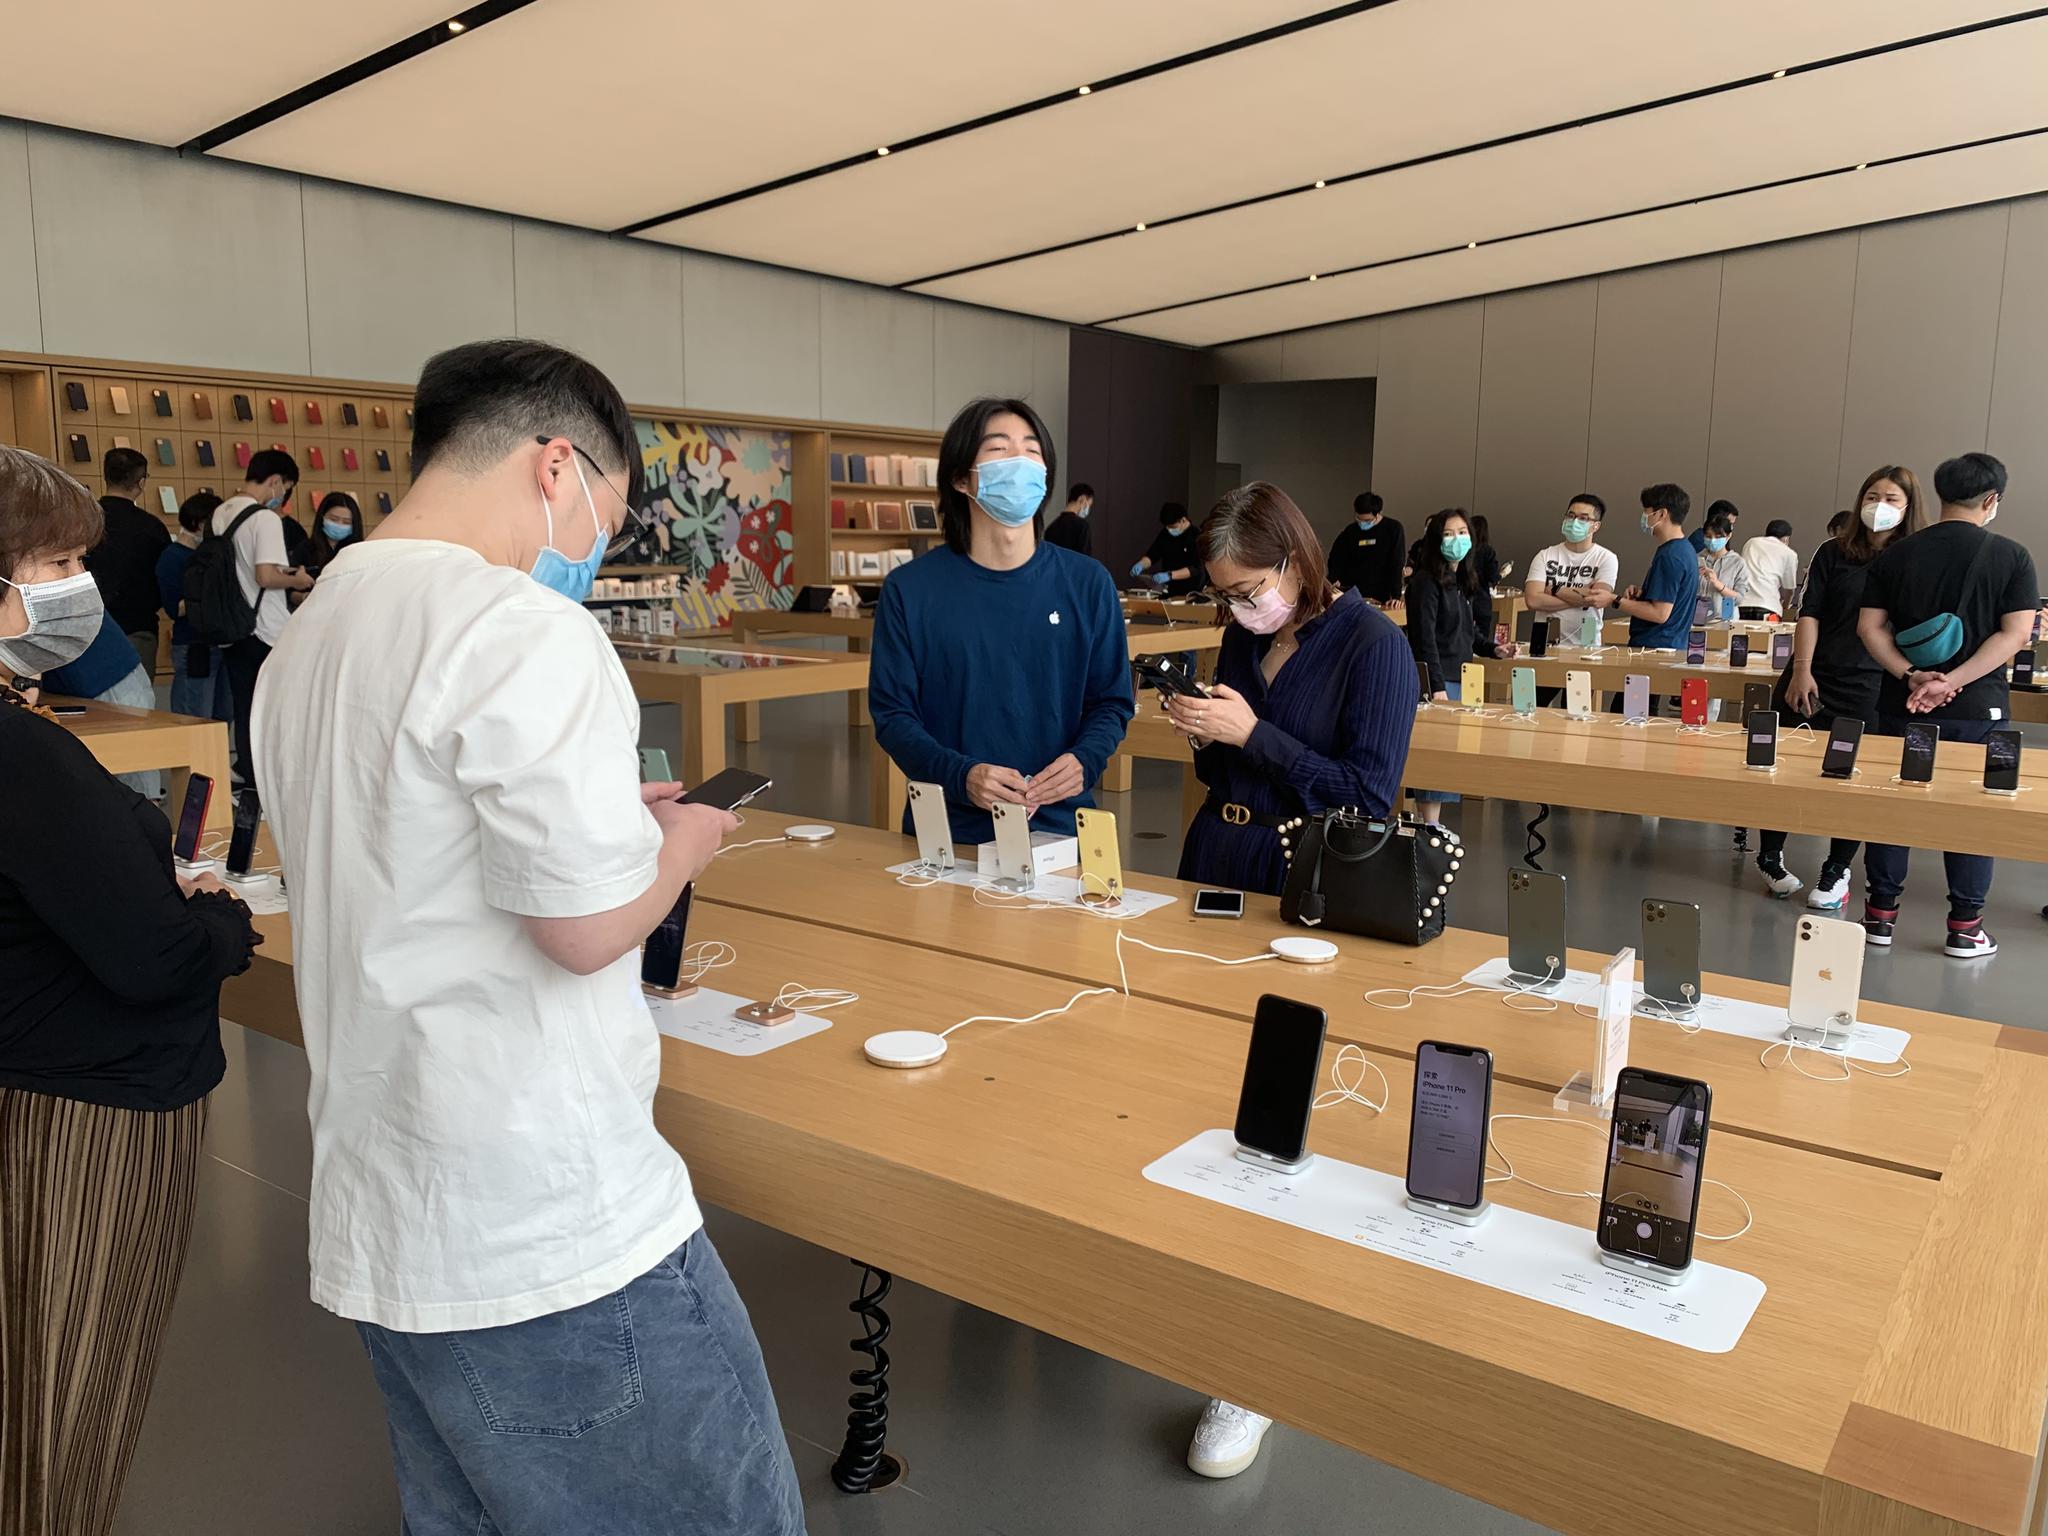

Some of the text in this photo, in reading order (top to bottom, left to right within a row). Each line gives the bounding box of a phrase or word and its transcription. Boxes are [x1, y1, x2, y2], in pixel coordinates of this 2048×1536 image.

[1545, 560, 1599, 582] Super
[1221, 802, 1251, 825] CD
[1423, 1081, 1445, 1090] iPhone
[1454, 1086, 1466, 1094] Pro
